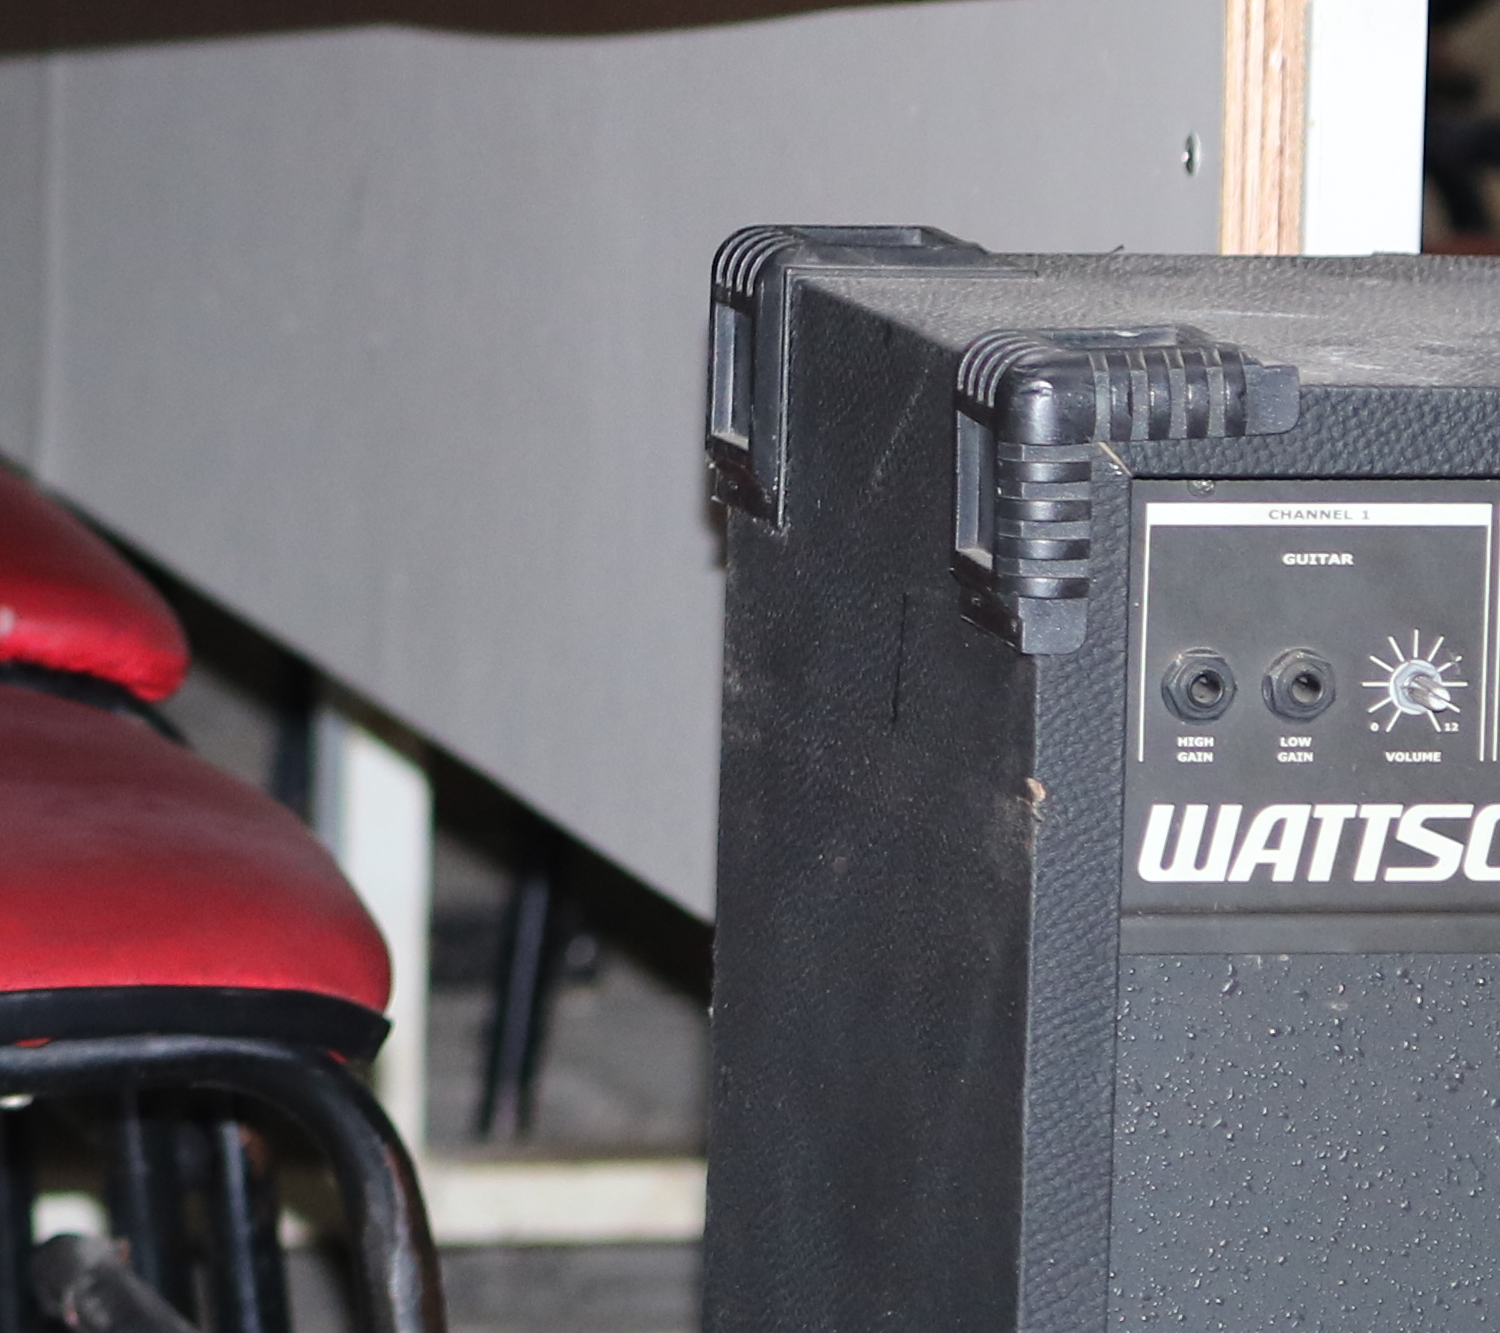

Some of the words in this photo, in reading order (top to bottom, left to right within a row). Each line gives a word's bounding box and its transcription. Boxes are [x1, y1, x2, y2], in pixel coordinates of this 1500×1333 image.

[1268, 510, 1353, 520] CHANNEL
[1362, 510, 1370, 520] 1
[1282, 553, 1355, 566] GUITAR
[1370, 722, 1379, 732] 0
[1444, 722, 1459, 732] 12
[1177, 736, 1215, 748] HIGH
[1280, 736, 1312, 748] LOW
[1177, 751, 1214, 763] GAIN
[1277, 751, 1314, 763] GAIN
[1385, 751, 1442, 763] VOLUME
